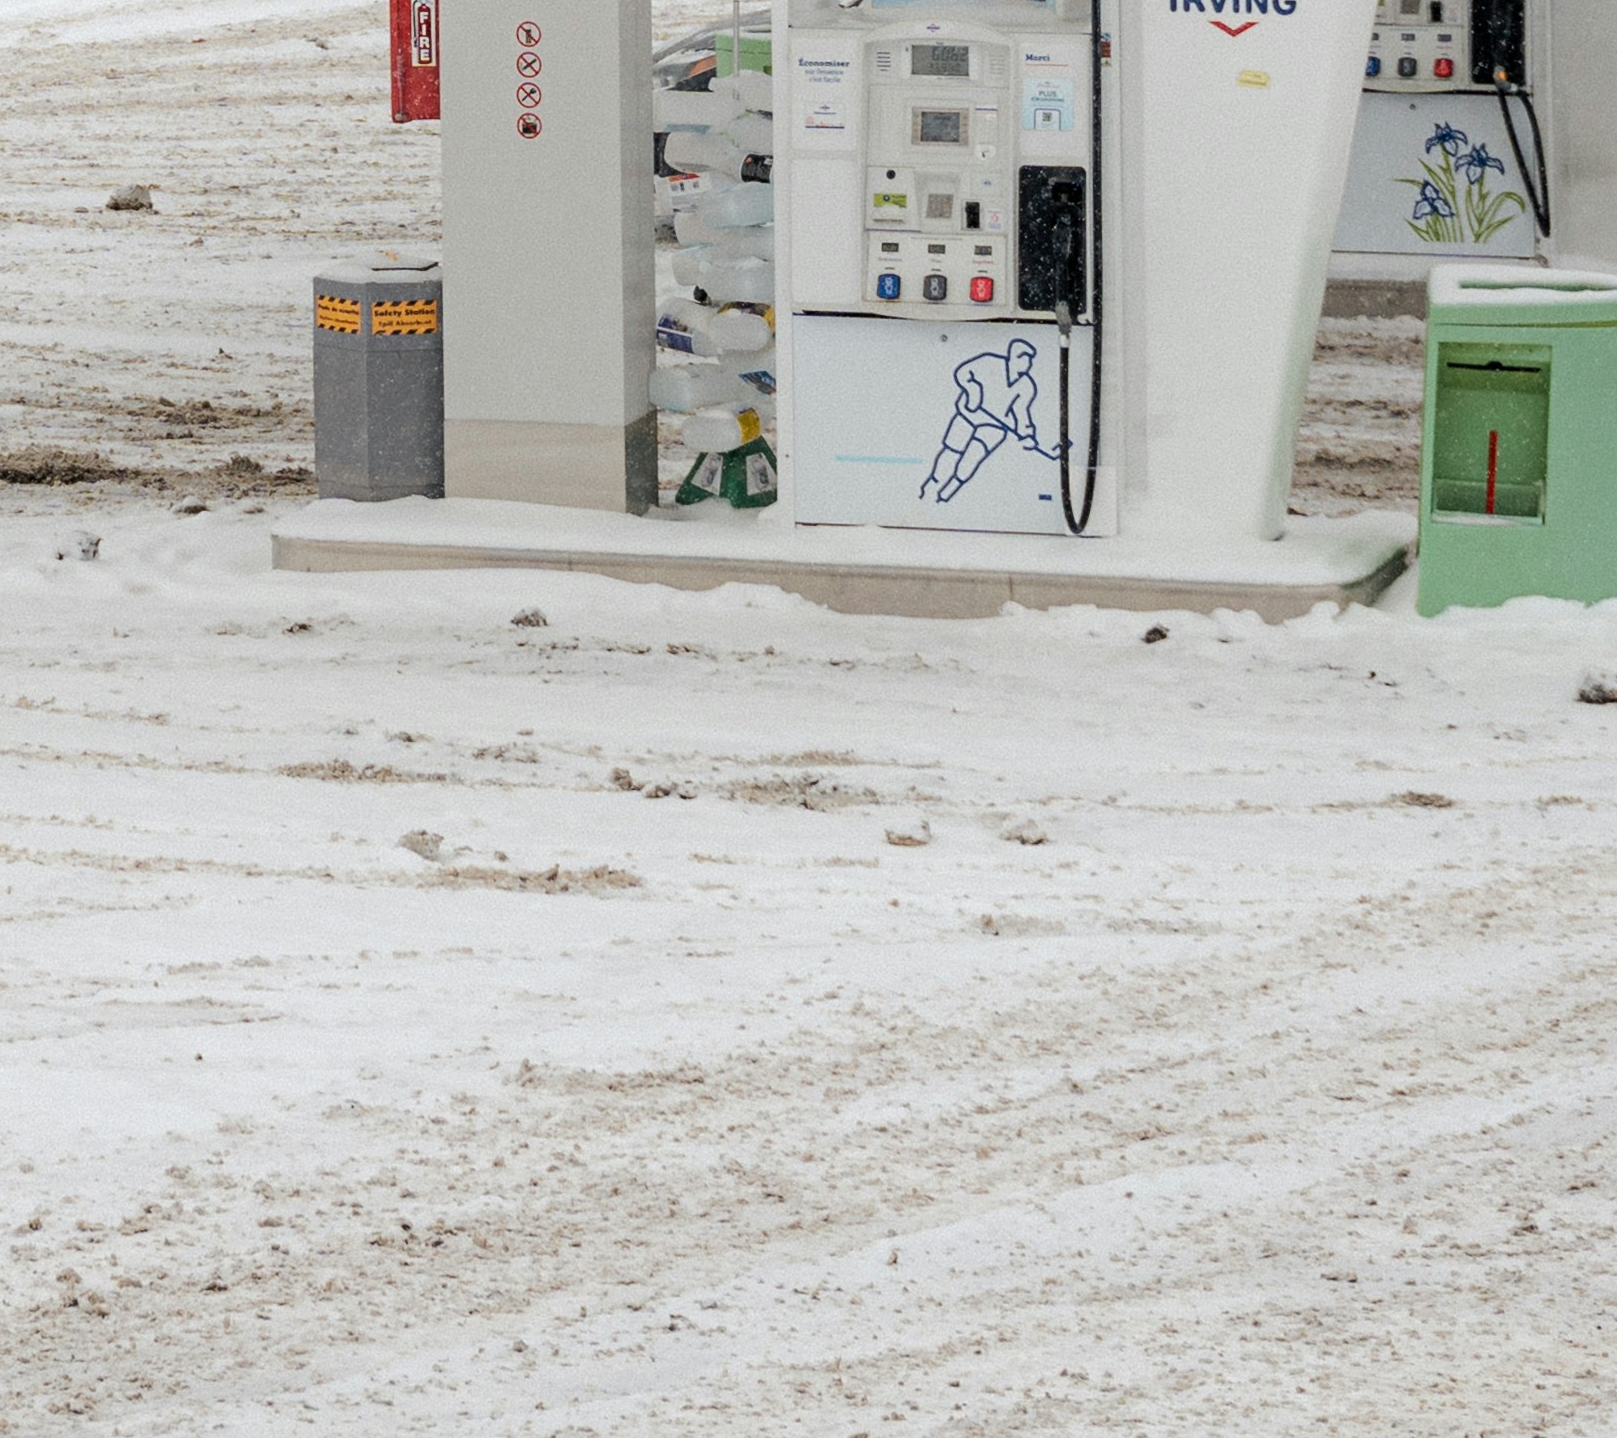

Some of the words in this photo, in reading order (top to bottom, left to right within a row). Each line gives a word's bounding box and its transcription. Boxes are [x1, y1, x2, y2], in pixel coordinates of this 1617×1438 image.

[419, 11, 430, 62] FIRE
[798, 56, 850, 67] Économiser
[1025, 53, 1050, 62] Merci
[374, 309, 402, 317] Safety
[405, 308, 436, 316] Station
